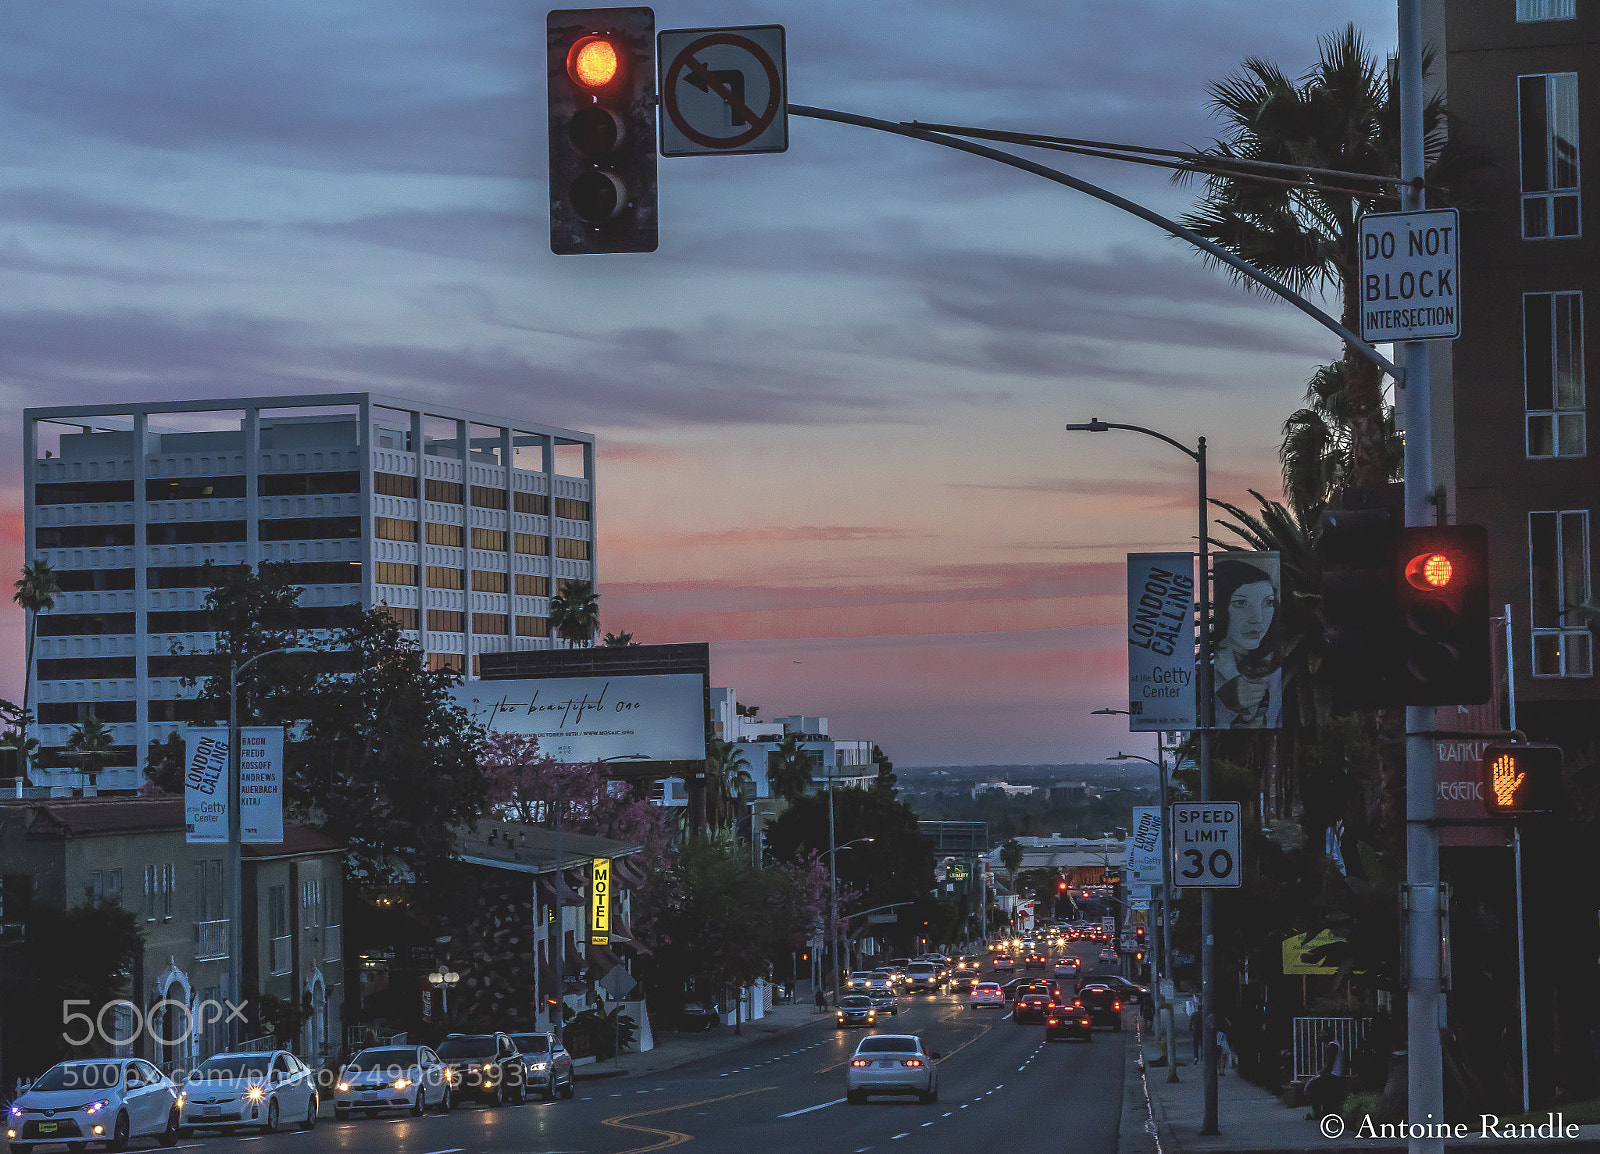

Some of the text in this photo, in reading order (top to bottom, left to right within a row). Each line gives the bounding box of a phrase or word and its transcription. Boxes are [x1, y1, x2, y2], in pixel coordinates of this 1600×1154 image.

[1365, 227, 1452, 260] DO NOT
[1366, 269, 1453, 302] BLOCK
[1366, 306, 1454, 330] INTERSECTION
[1128, 567, 1174, 650] LONDON
[1151, 573, 1195, 656] CALLING
[1152, 666, 1192, 687] Getty
[1142, 685, 1181, 698] Center
[527, 681, 609, 729] beautiful
[242, 737, 266, 746] BACON
[1436, 742, 1490, 762] RANKL
[185, 736, 215, 790] LONDON
[241, 749, 265, 758] FREUD
[200, 741, 229, 795] CALLING
[241, 761, 272, 770] KOSSOFF
[241, 773, 276, 782] ANDREWS
[241, 785, 278, 794] AUERBACH
[194, 813, 219, 823] Center
[200, 801, 226, 815] Getty
[1179, 810, 1235, 823] SPEED
[1134, 812, 1153, 850] LONDON
[1184, 830, 1228, 842] LIMIT
[1181, 848, 1233, 879] 30
[594, 869, 607, 929] MOTEL
